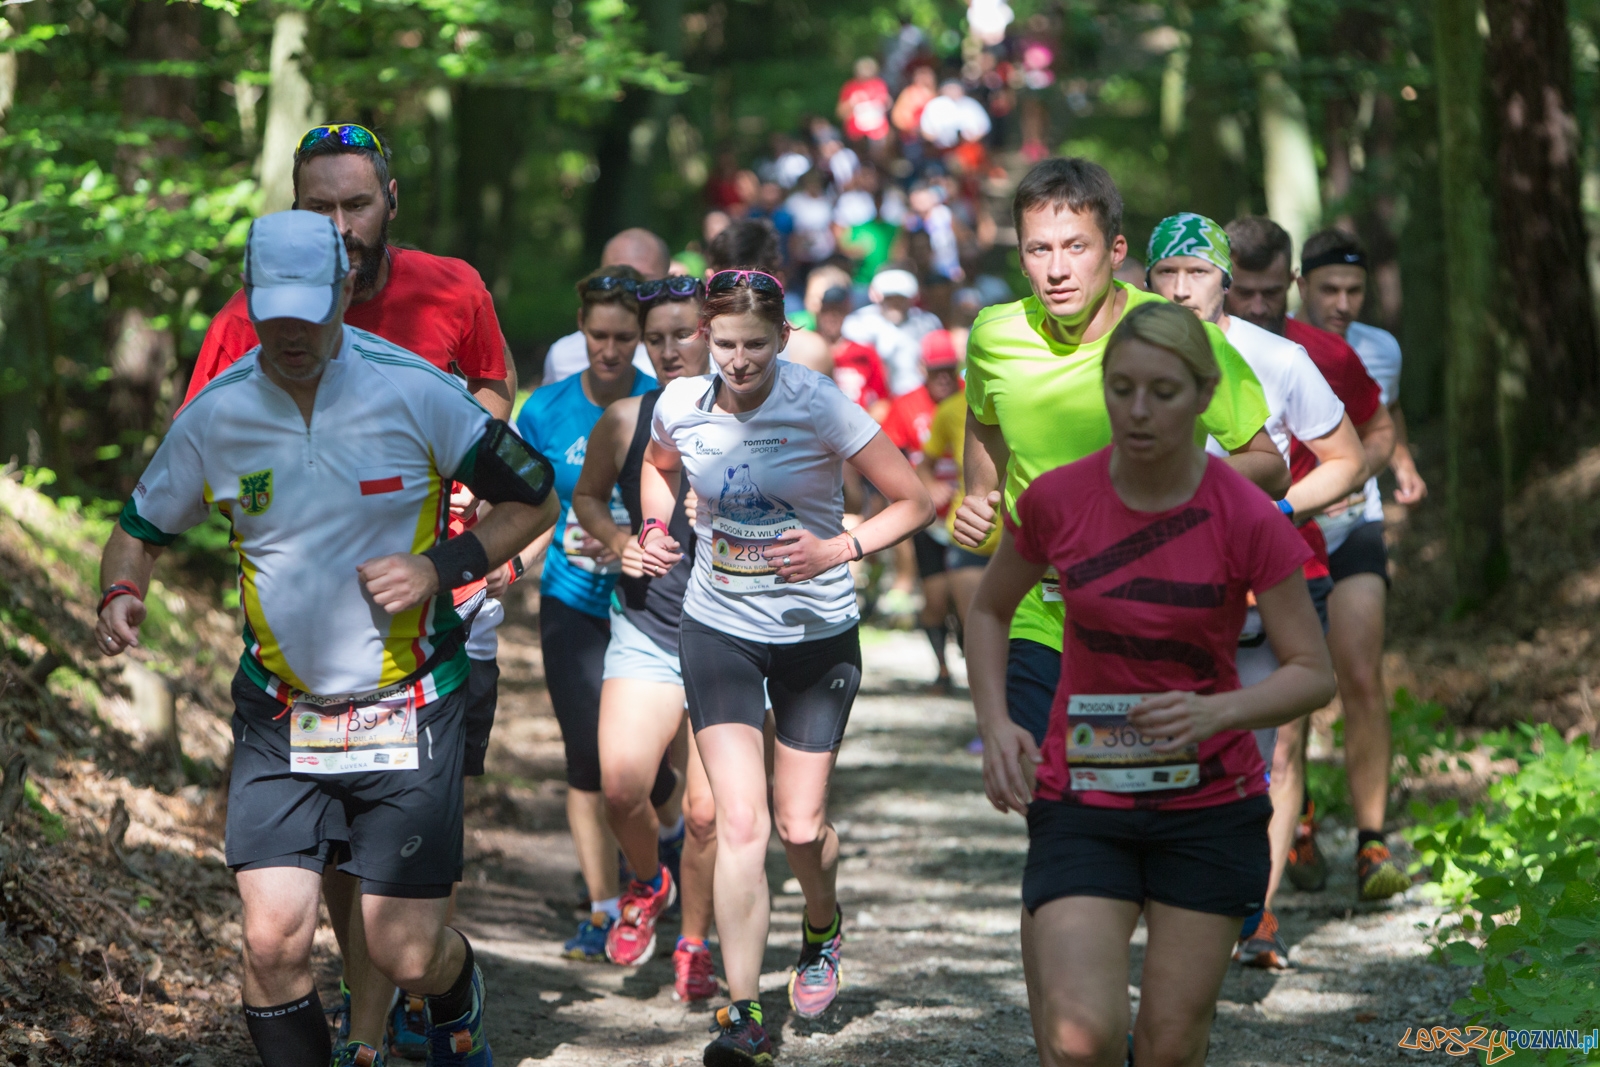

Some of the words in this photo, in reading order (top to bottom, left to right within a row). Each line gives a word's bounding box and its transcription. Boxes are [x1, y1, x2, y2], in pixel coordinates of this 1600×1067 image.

[743, 438, 780, 446] TOMTOM
[750, 446, 779, 454] SPORTS
[720, 522, 743, 536] POGOŃ
[744, 530, 756, 538] ZA
[1078, 701, 1115, 712] POGOŃ
[332, 708, 378, 732] 189
[329, 736, 352, 744] PIOTR
[340, 762, 368, 770] LUVENA
